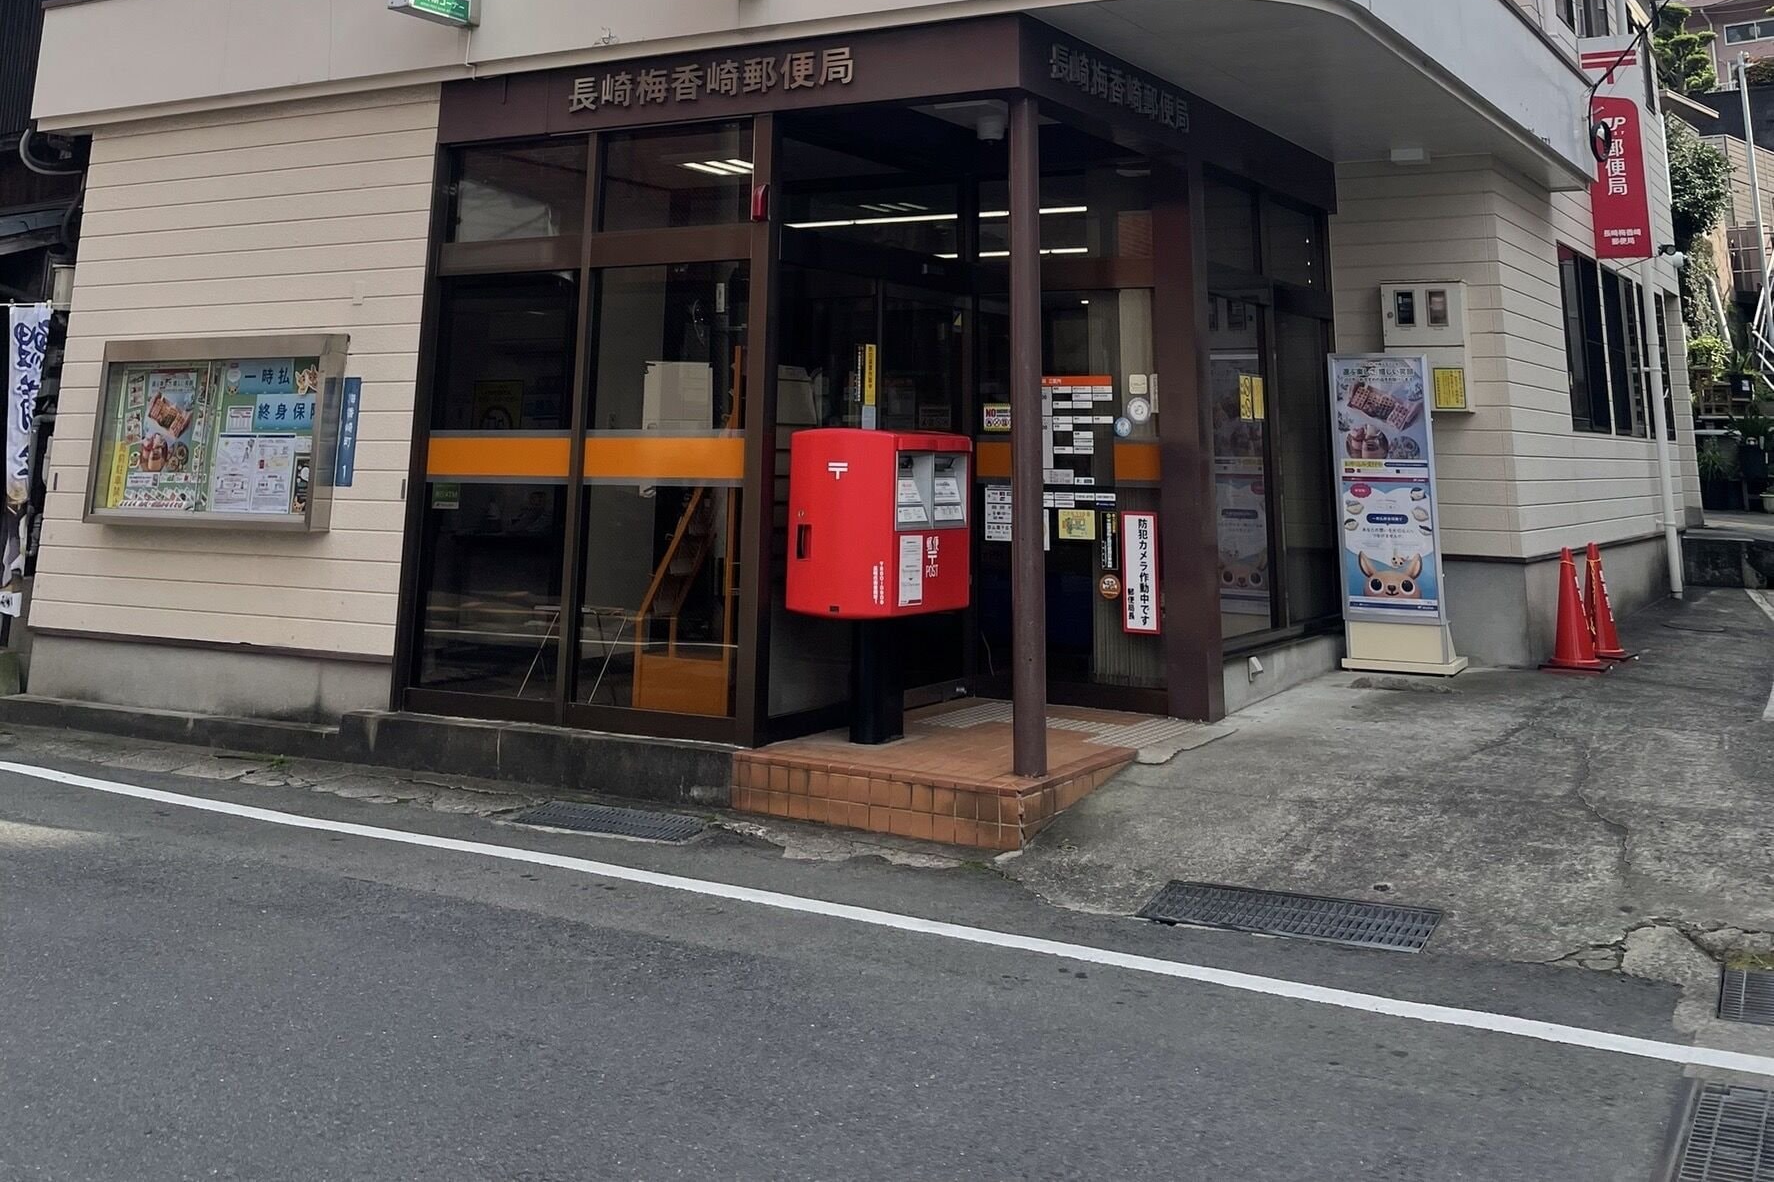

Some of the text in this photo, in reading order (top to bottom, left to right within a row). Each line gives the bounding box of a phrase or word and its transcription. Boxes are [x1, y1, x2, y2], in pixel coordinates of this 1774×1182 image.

[568, 47, 854, 114] 長崎梅香崎郵便局
[1050, 43, 1190, 134] 長崎梅香崎郵便局
[244, 367, 291, 386] 一時払
[925, 564, 939, 579] POST
[1137, 518, 1150, 626] 防犯カメラ作動中です
